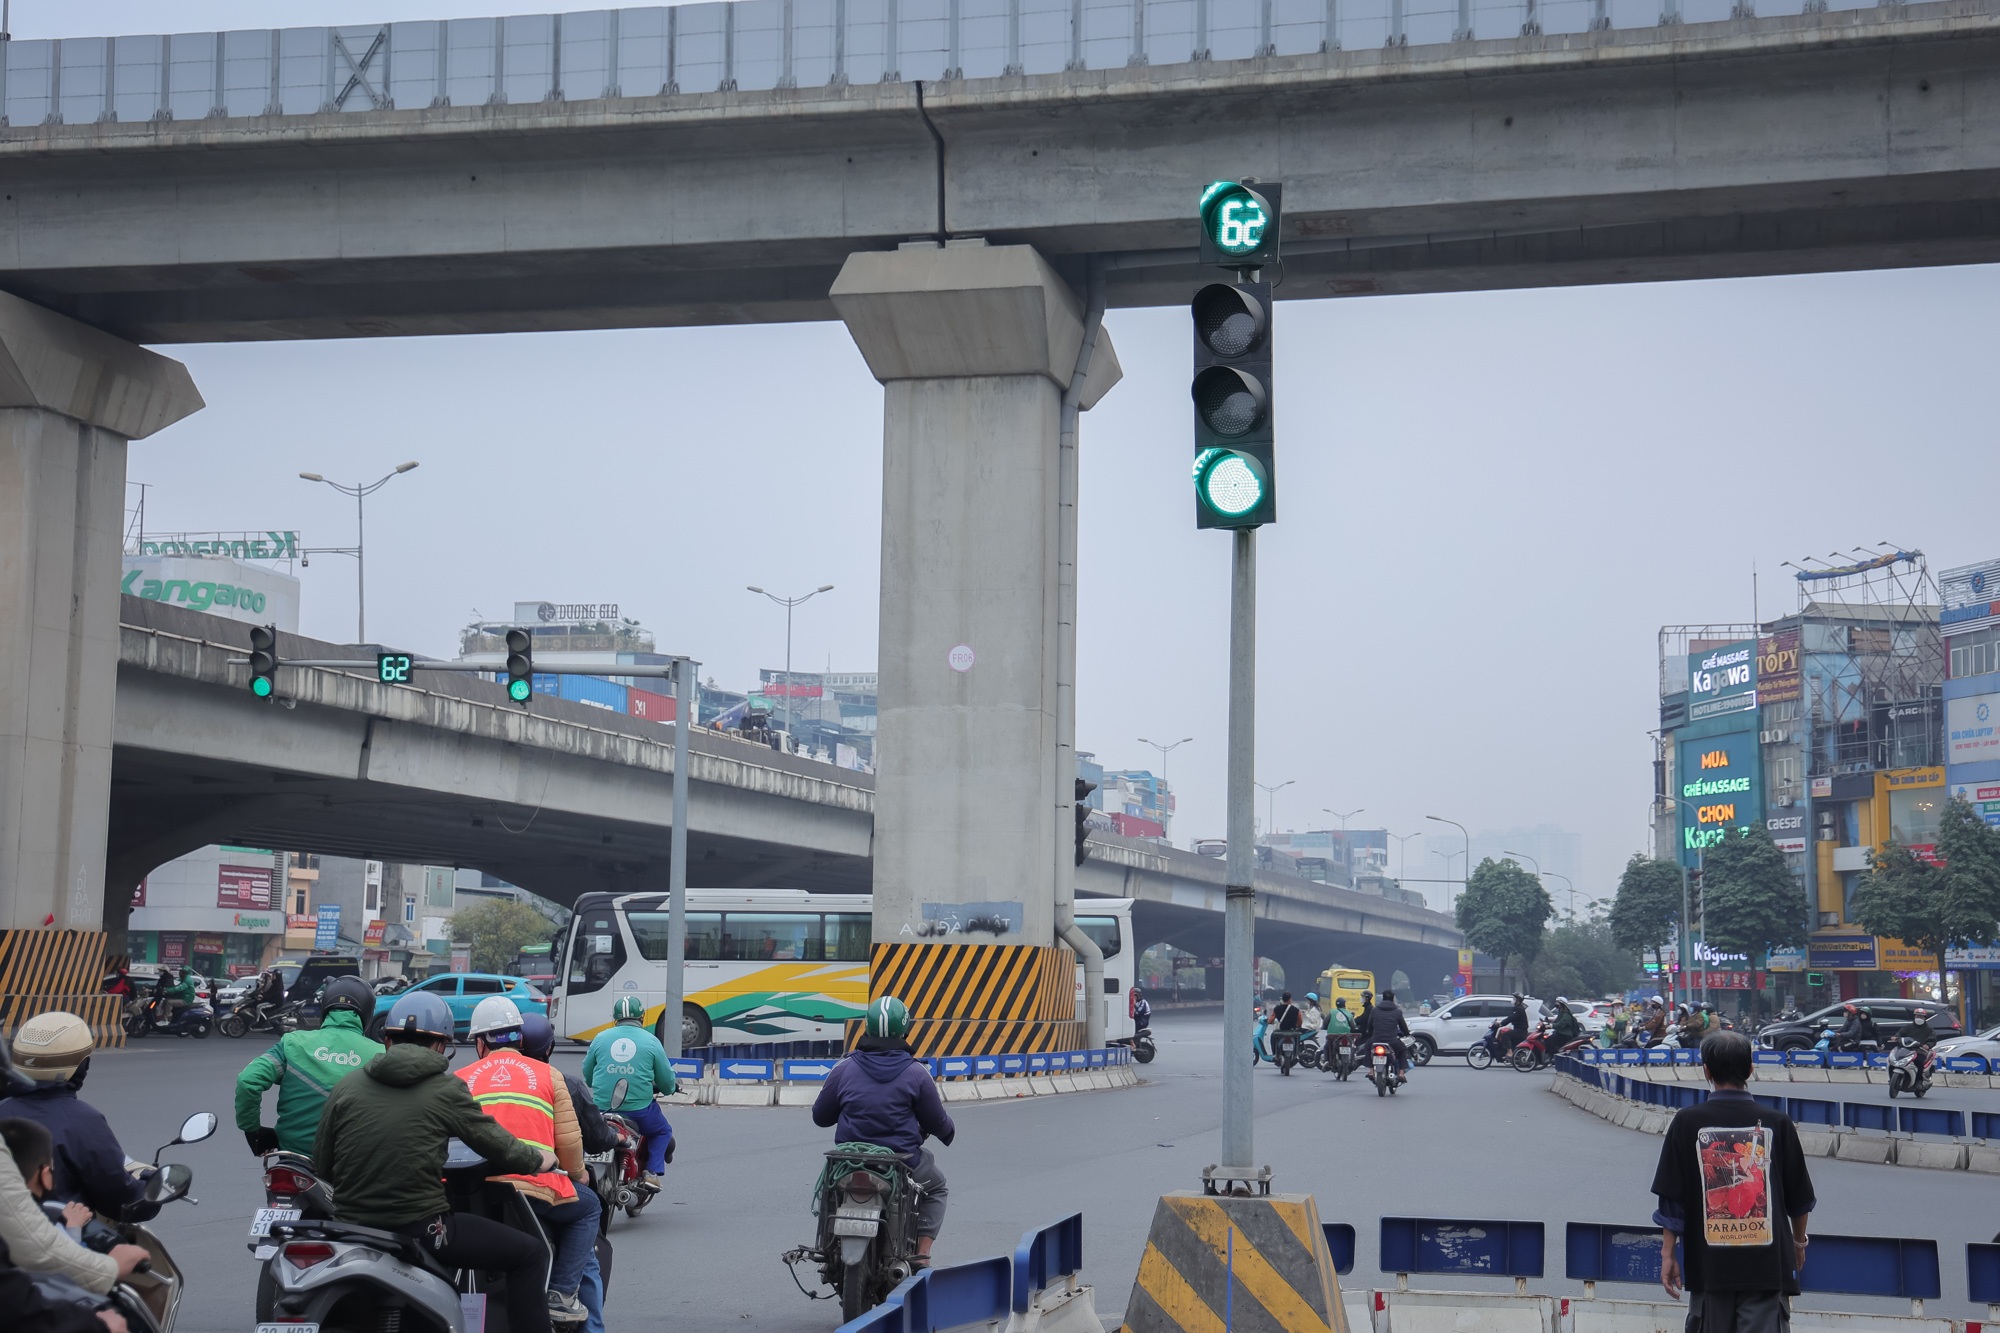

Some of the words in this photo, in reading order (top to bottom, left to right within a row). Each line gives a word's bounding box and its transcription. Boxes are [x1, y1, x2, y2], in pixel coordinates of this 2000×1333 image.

[1221, 200, 1267, 247] 62
[1716, 650, 1750, 667] MASSAGE
[1756, 649, 1799, 674] TOPY
[381, 657, 410, 681] 62
[1693, 664, 1750, 695] Kagawa
[1701, 750, 1729, 769] MUA
[1683, 778, 1701, 797] GHẾ
[1701, 777, 1750, 796] MASSAGE
[1697, 804, 1735, 826] CHỌN
[899, 923, 914, 936] A
[314, 1046, 361, 1066] Grab
[607, 1063, 634, 1074] Grab
[261, 1210, 294, 1221] 29-H1
[1707, 1221, 1766, 1233] PARADOX
[1719, 1232, 1759, 1241] WORLDWIDE
